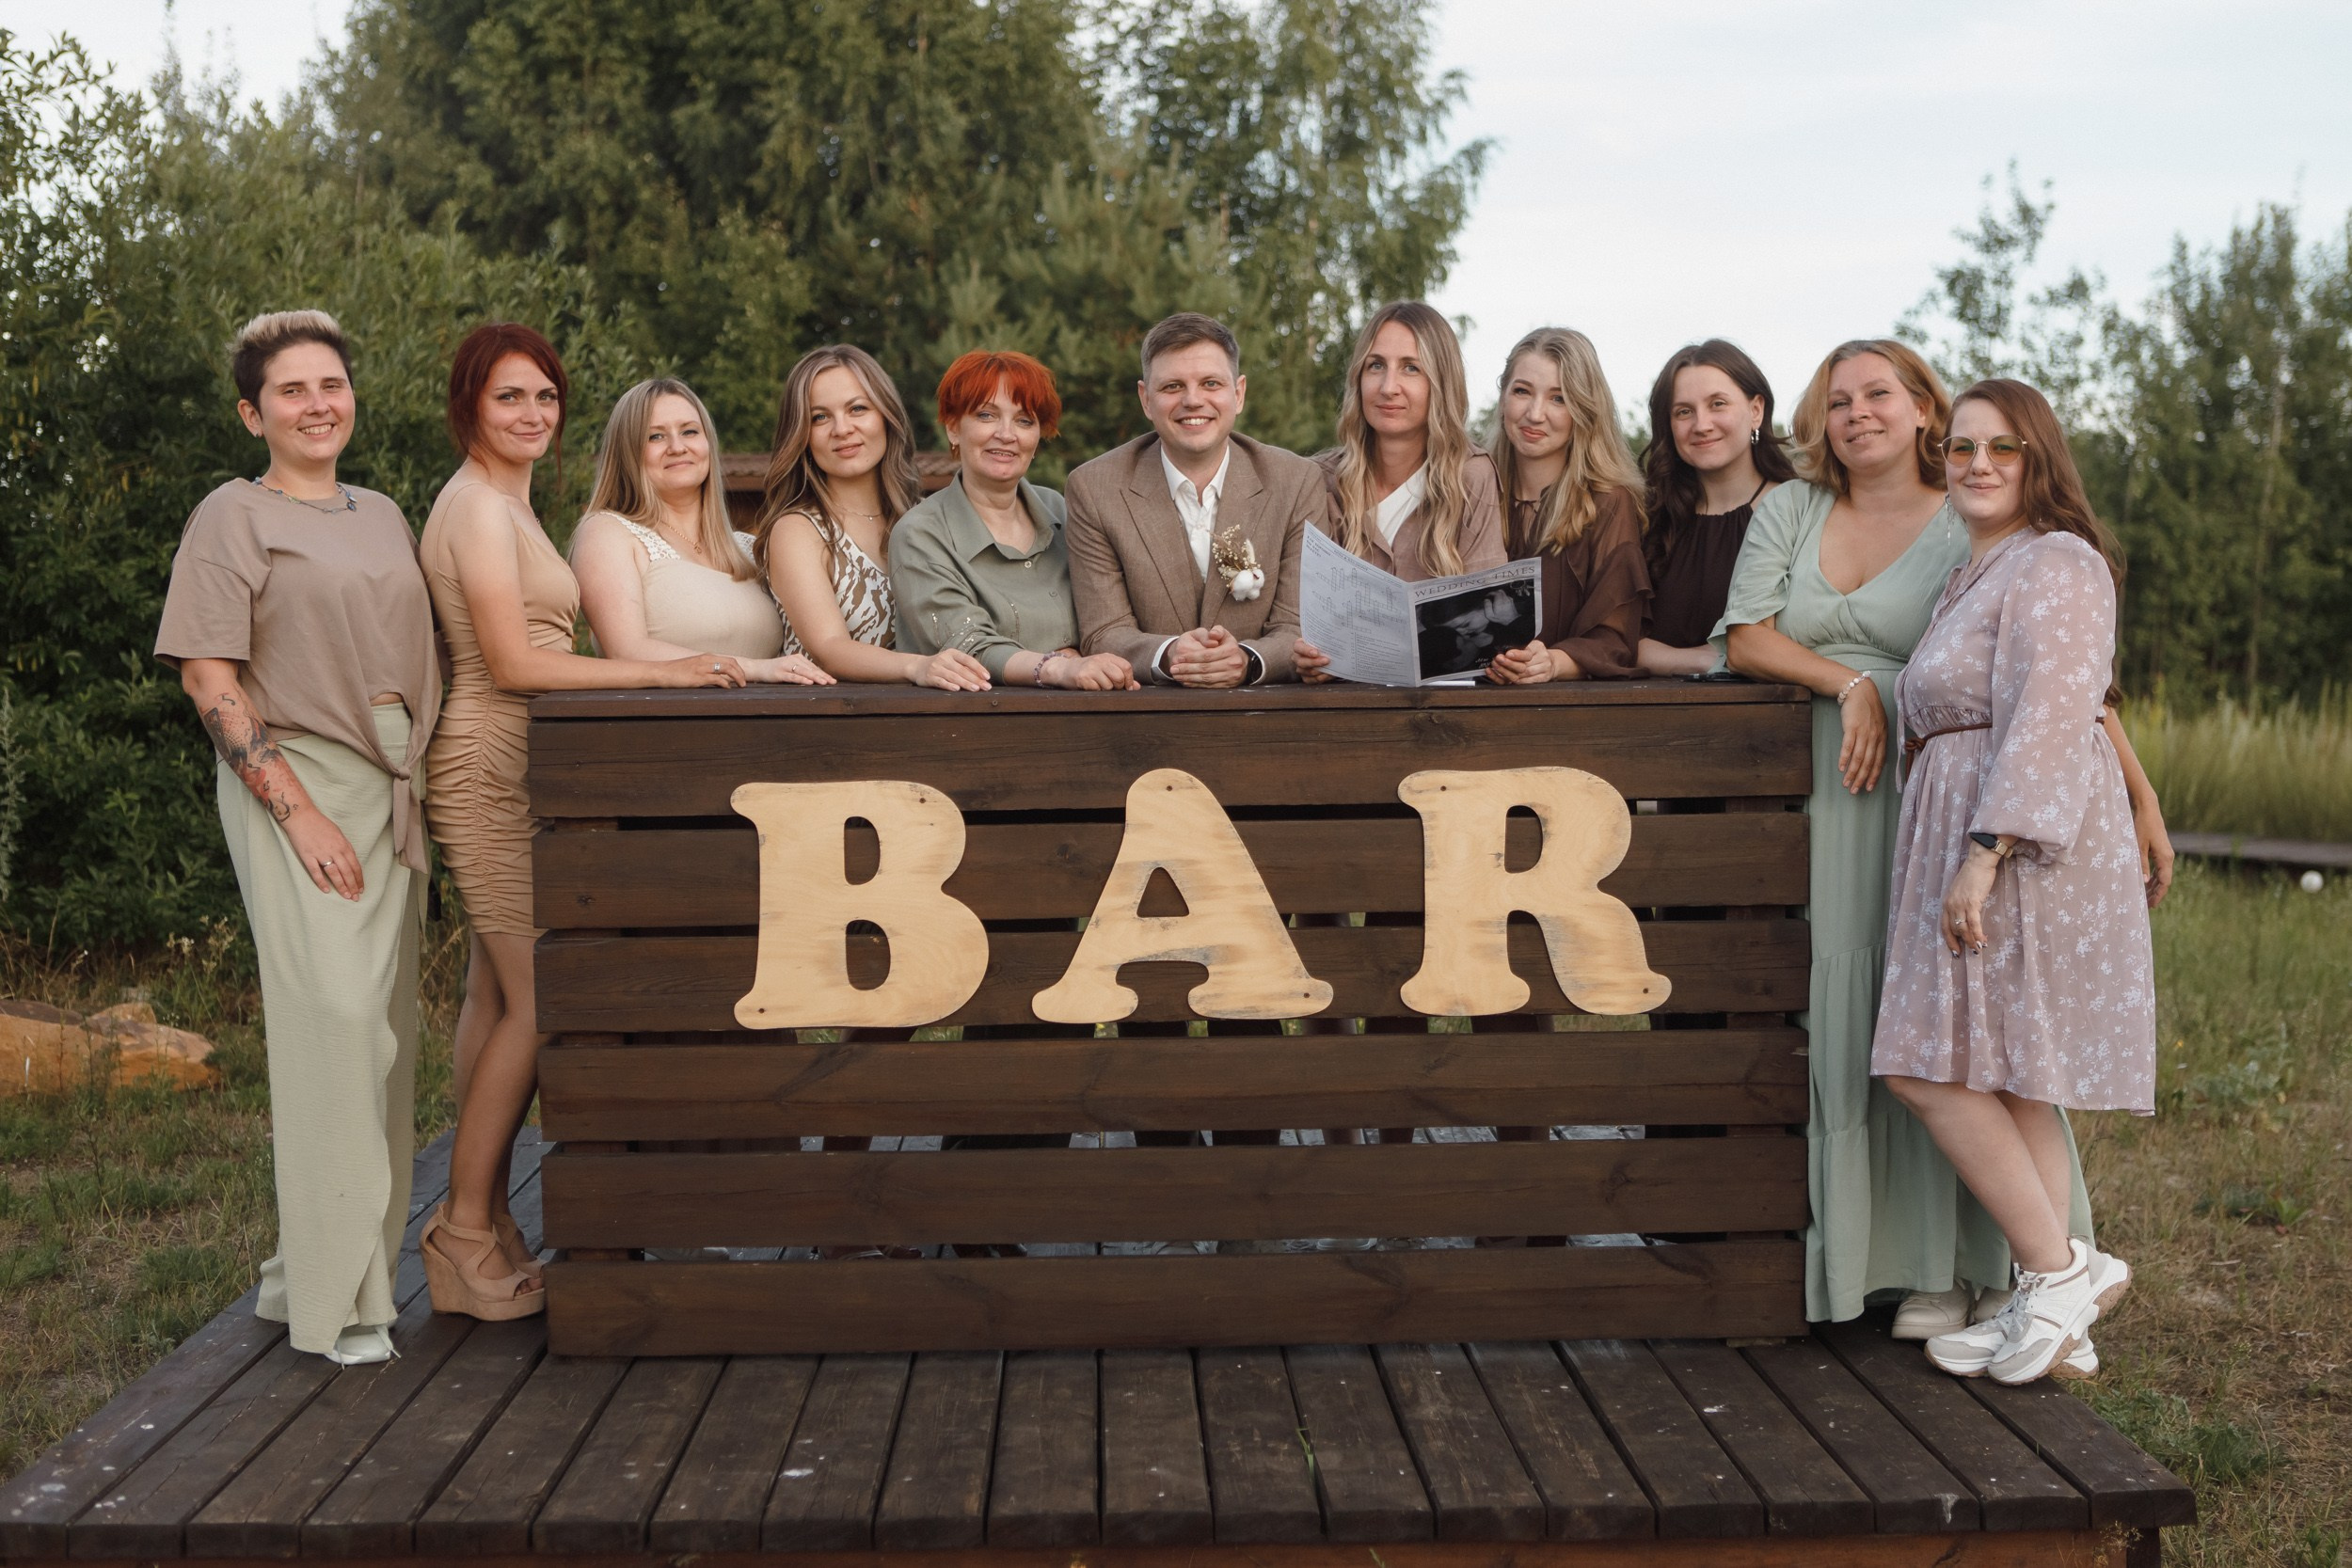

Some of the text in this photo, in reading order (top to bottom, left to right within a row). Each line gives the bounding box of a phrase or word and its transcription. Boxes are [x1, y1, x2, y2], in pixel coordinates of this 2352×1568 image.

[1415, 578, 1486, 598] WEDDING
[1493, 565, 1535, 579] TIMES
[730, 766, 1672, 1029] BAR
